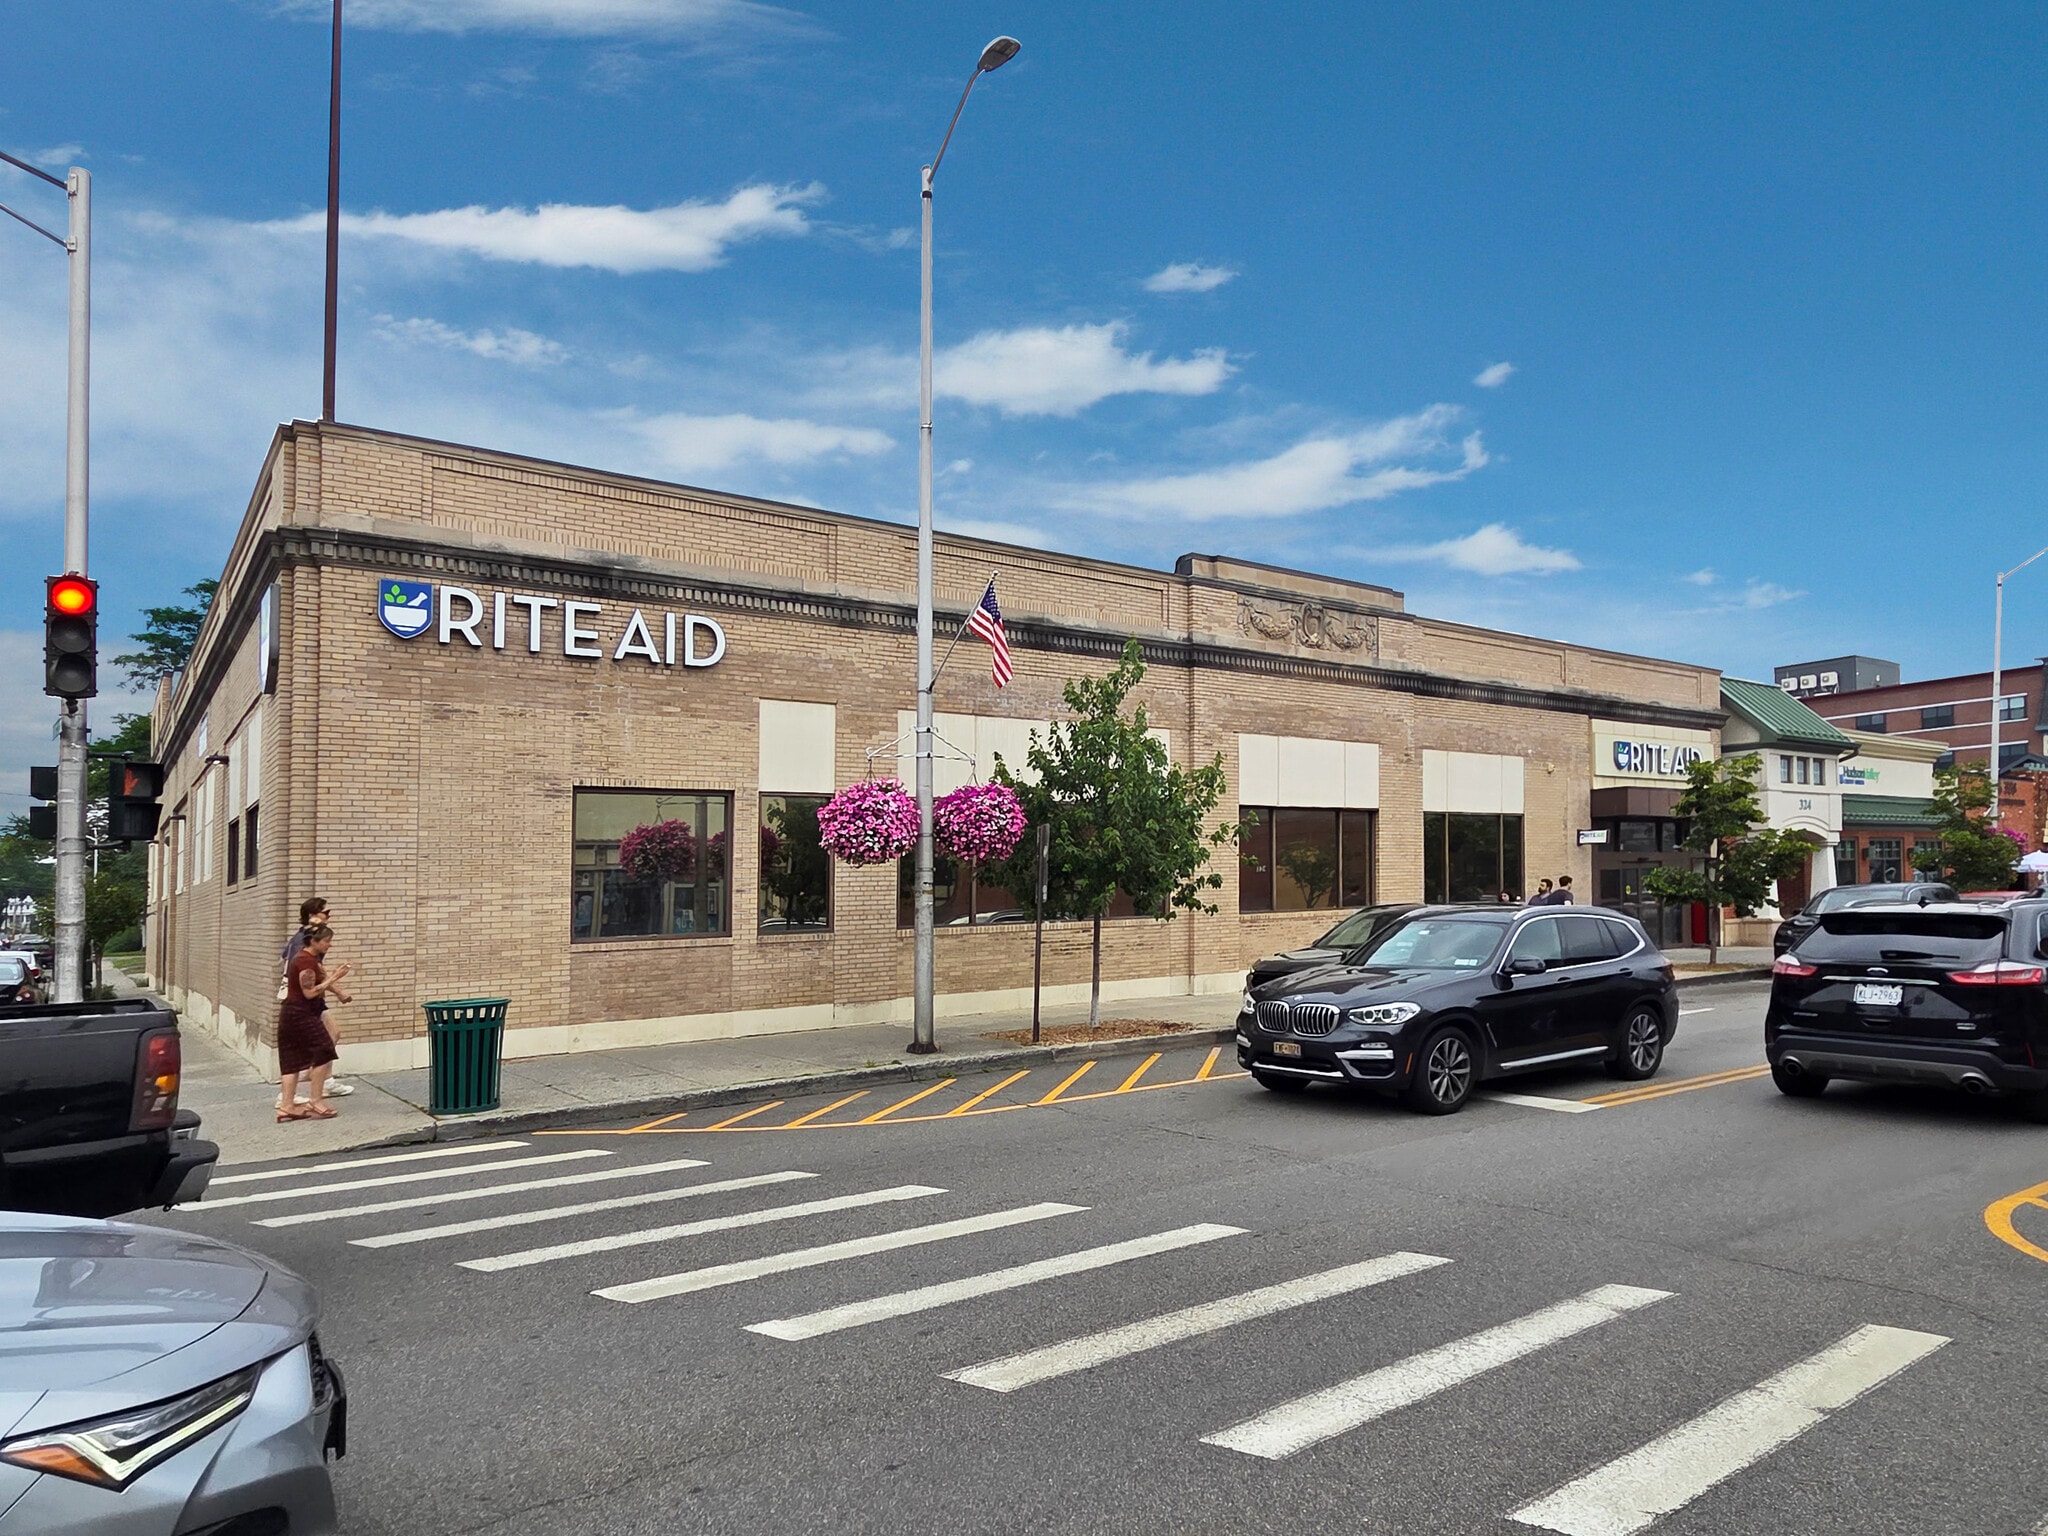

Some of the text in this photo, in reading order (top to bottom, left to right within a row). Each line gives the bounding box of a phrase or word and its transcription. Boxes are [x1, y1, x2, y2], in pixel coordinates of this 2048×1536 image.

[438, 585, 727, 668] RITE AID
[1630, 741, 1671, 774] RITE
[1799, 799, 1811, 811] 324
